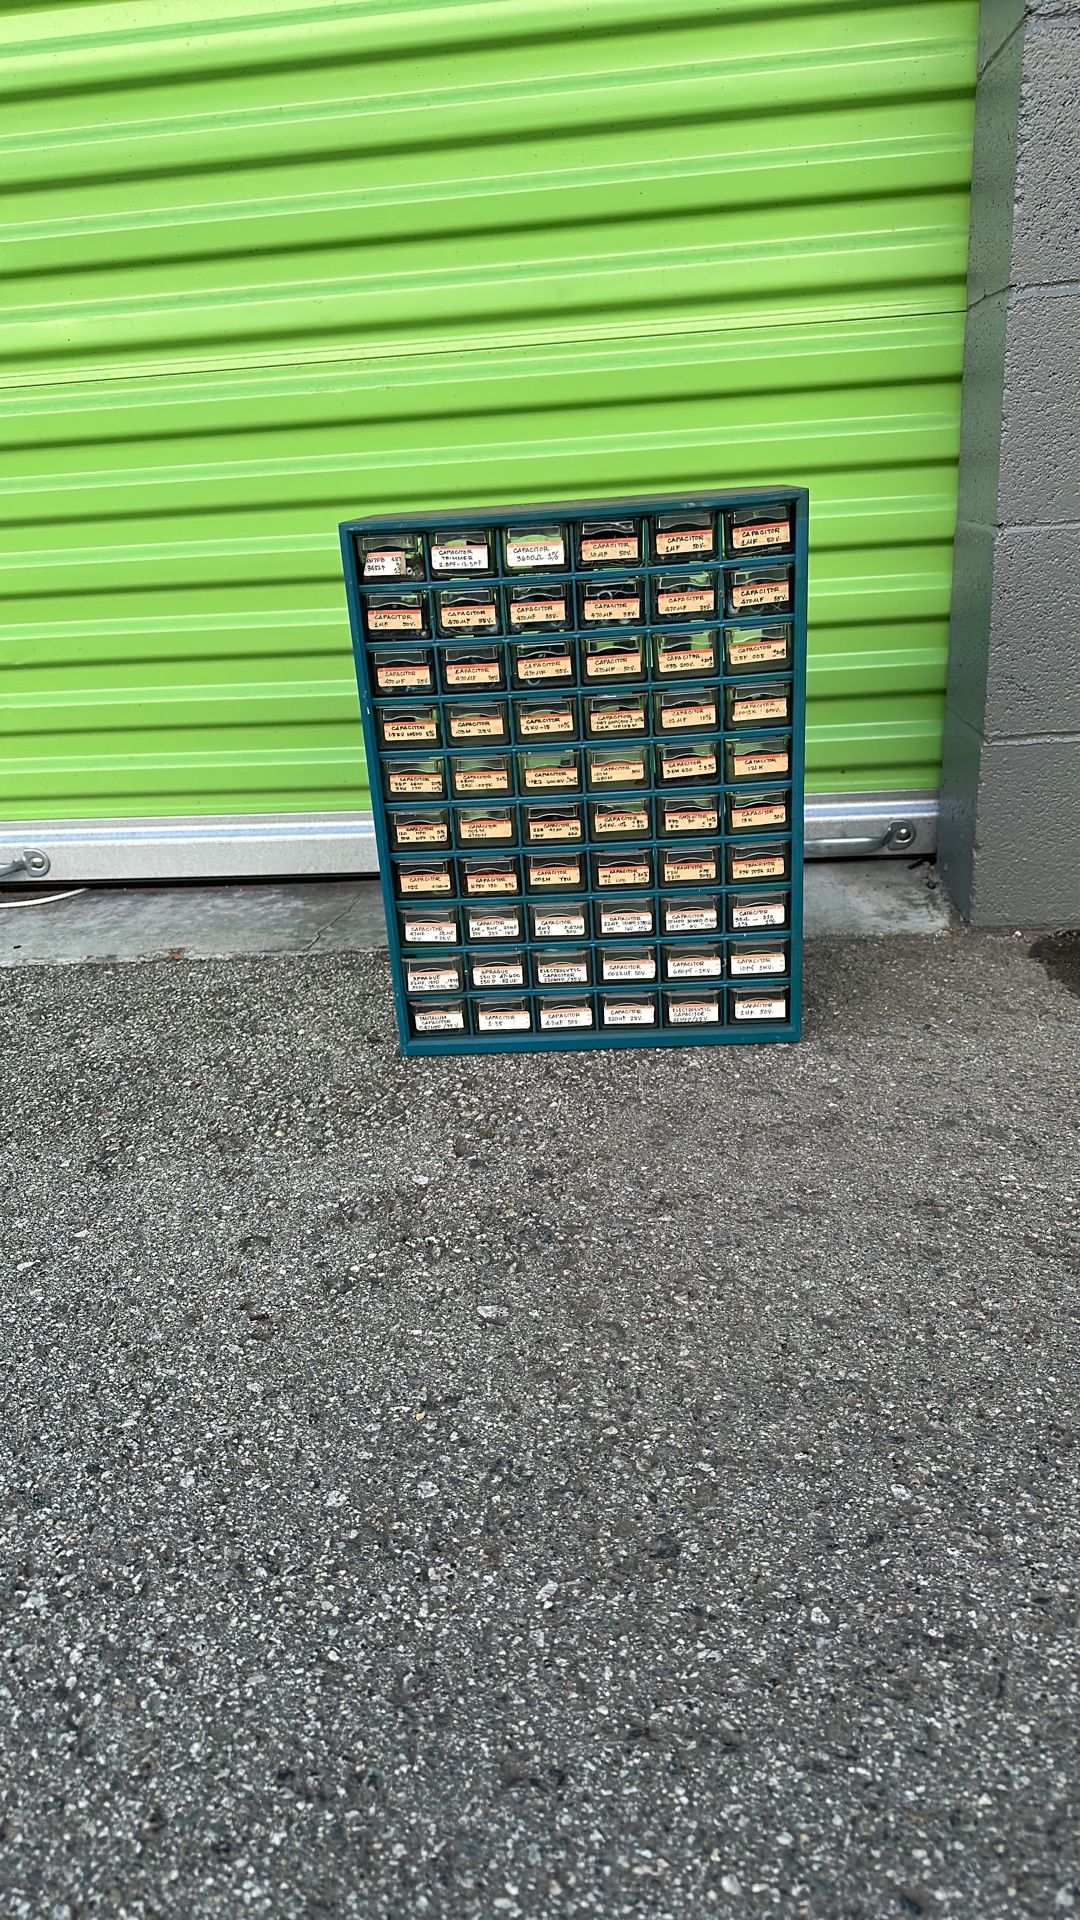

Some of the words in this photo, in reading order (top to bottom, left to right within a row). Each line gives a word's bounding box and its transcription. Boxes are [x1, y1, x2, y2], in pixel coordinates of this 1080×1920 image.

[742, 528, 780, 538] CAPACITOR
[668, 535, 704, 544] CAPACITOR
[741, 587, 779, 597] CAPACITOR
[738, 645, 772, 654] CAPACITOR
[524, 661, 561, 669] CAPACITOR
[742, 809, 774, 817] CAPACITOR
